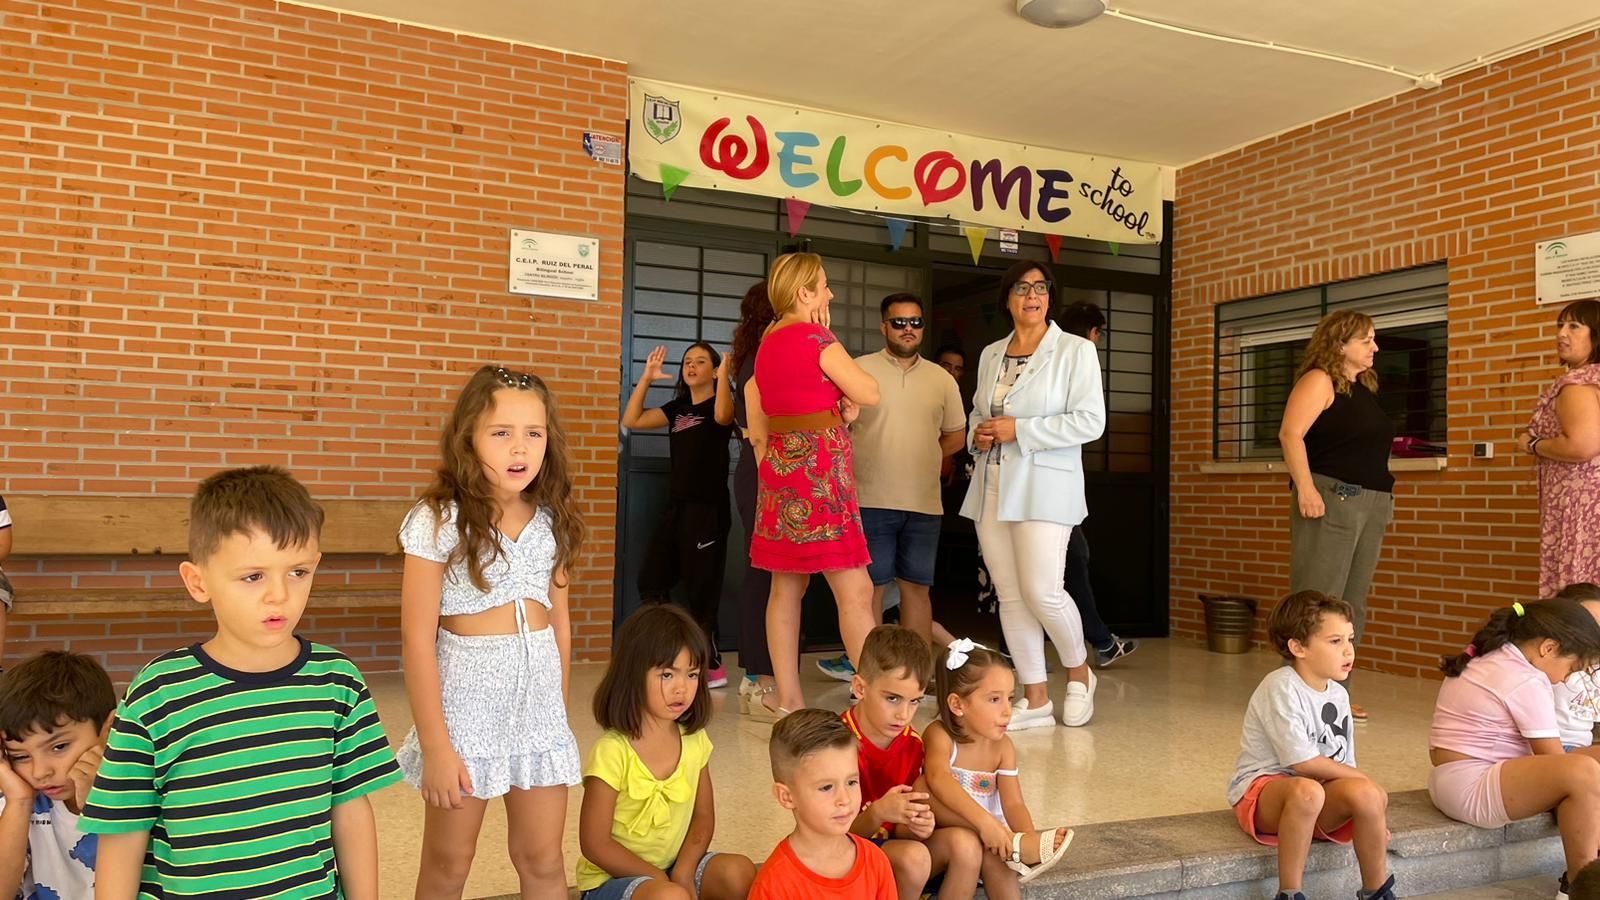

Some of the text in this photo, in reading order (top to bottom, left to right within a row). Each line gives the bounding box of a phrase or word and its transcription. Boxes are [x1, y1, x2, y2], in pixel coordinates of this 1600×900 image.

[699, 115, 1074, 223] WELCOME
[1111, 166, 1134, 197] to
[1078, 182, 1149, 237] school
[516, 257, 538, 265] C.E.I.P.
